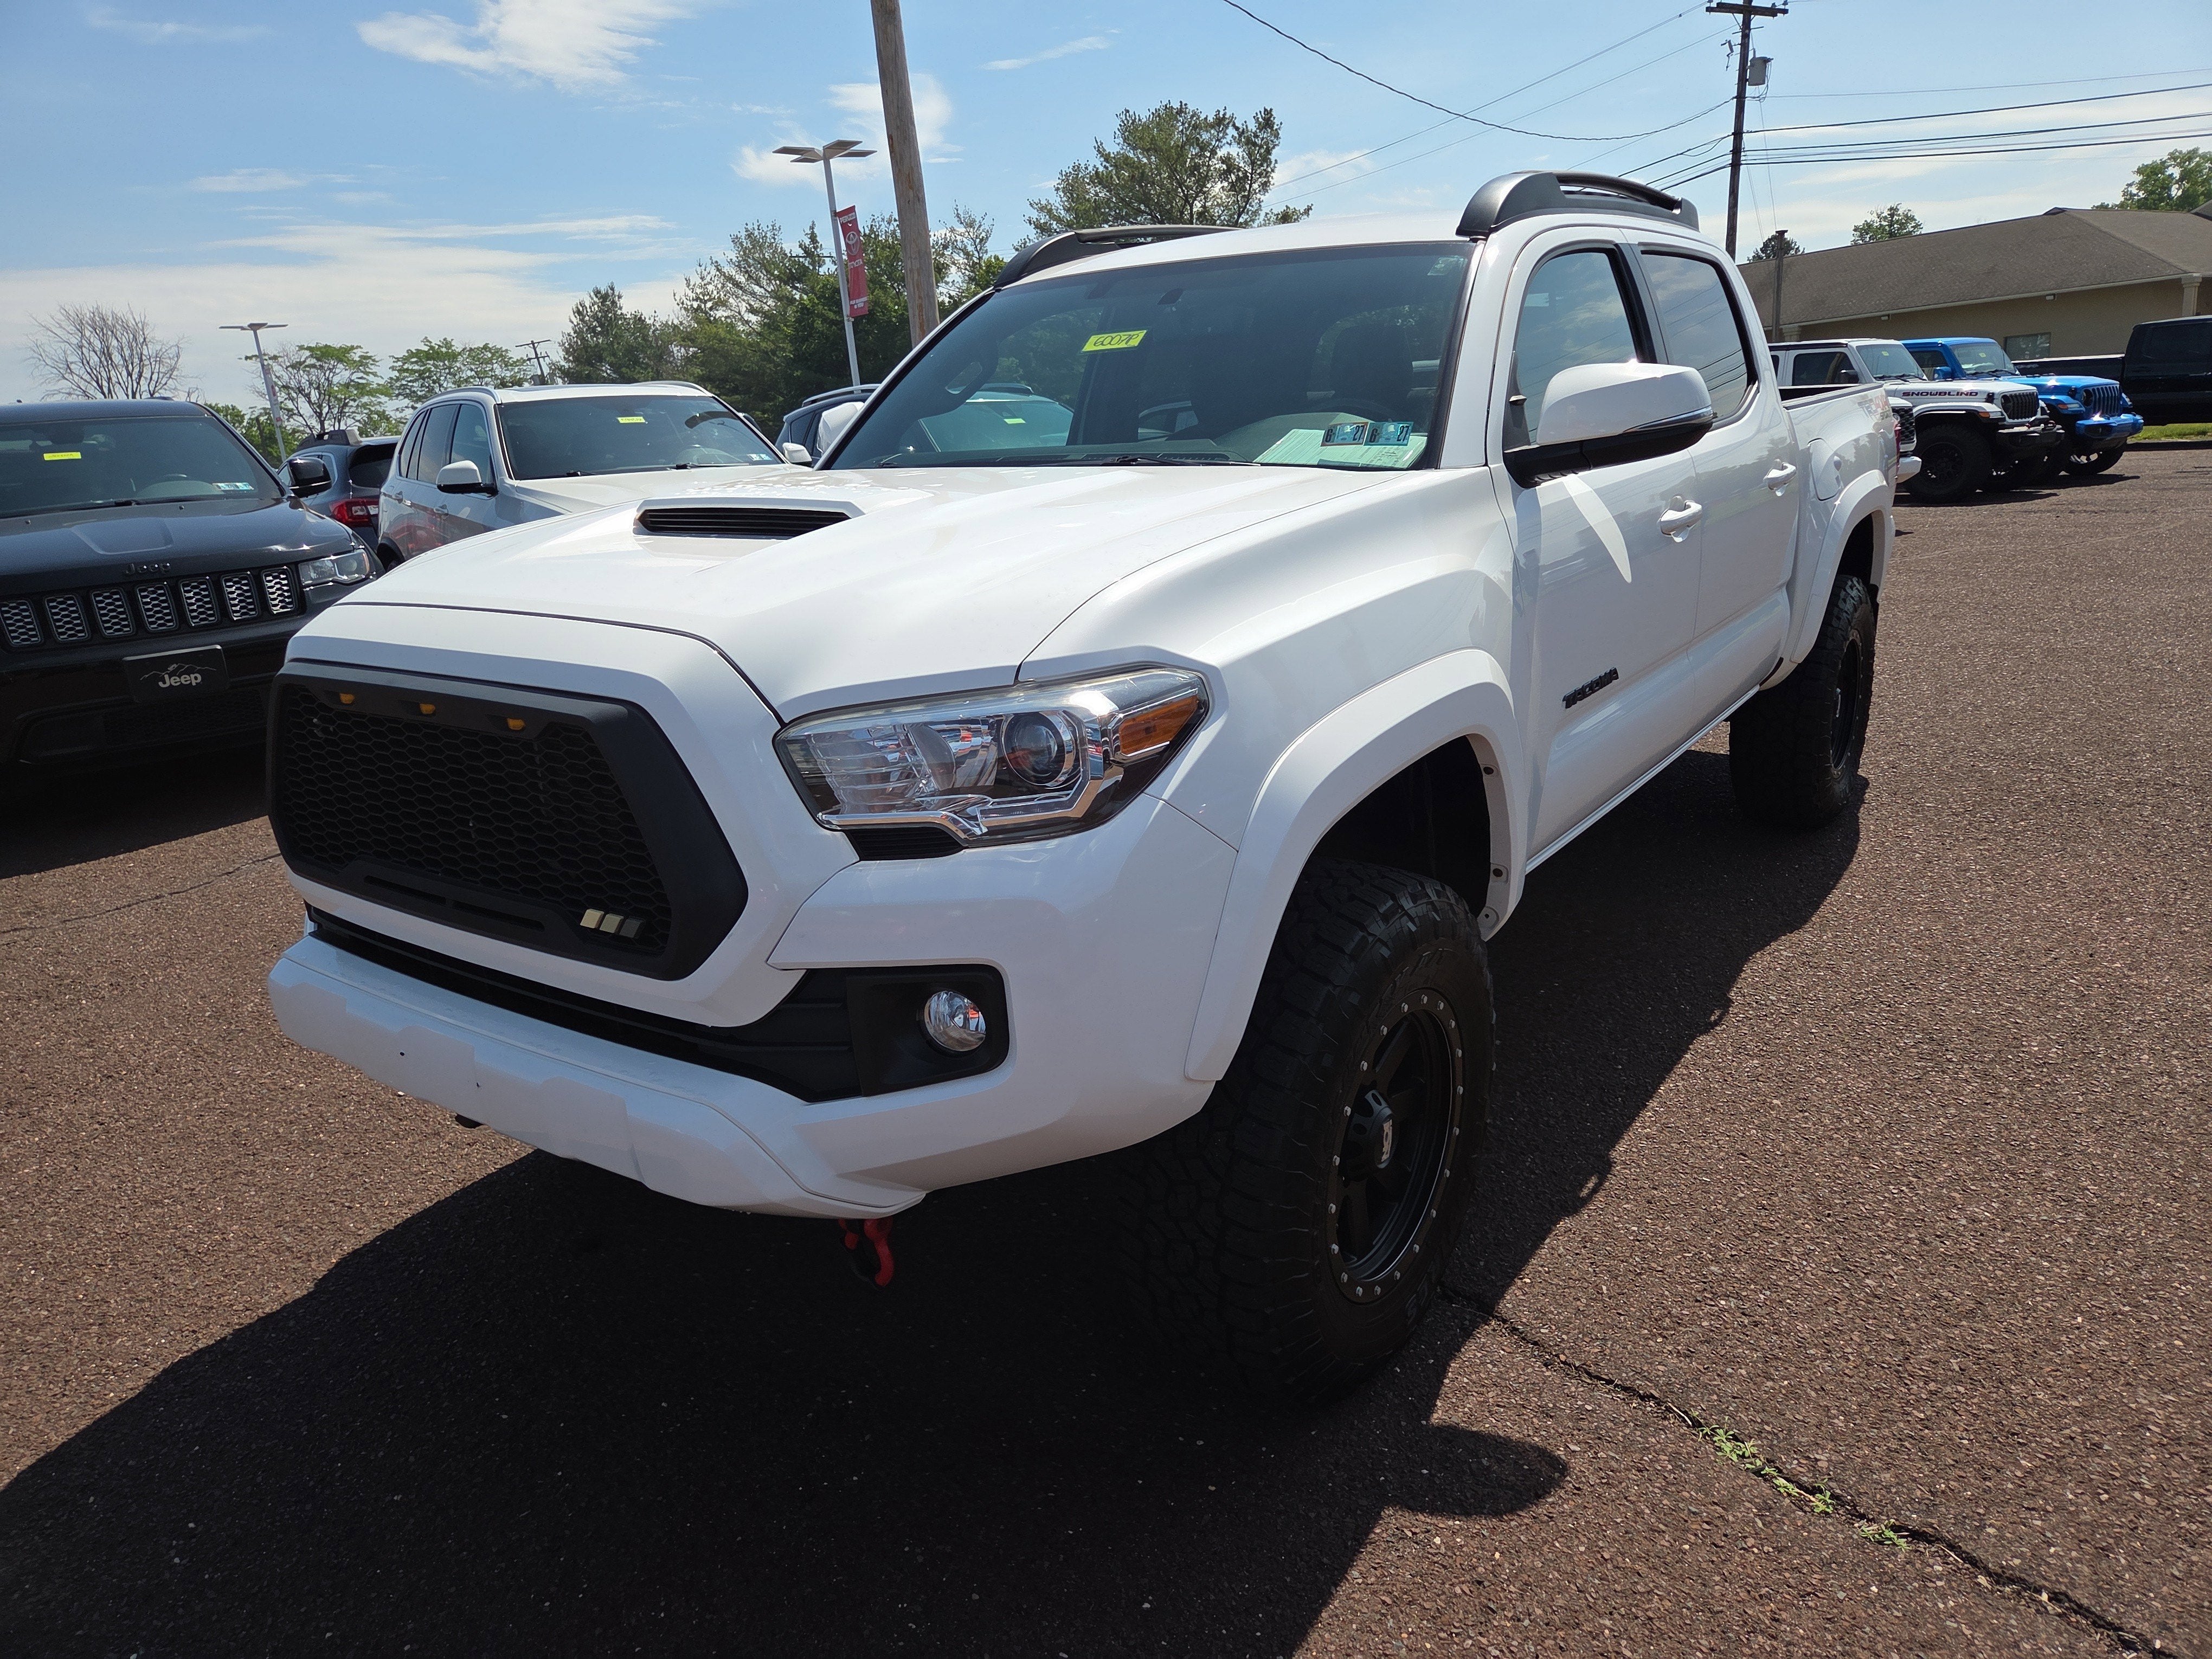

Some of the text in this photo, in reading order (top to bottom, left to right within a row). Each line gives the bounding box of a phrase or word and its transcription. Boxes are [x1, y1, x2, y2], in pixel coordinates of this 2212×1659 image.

[1353, 425, 1365, 442] 27
[1369, 425, 1410, 442] 6 27
[125, 562, 171, 575] Jeep
[158, 673, 202, 688] Jeep
[1562, 666, 1619, 709] TACOMA
